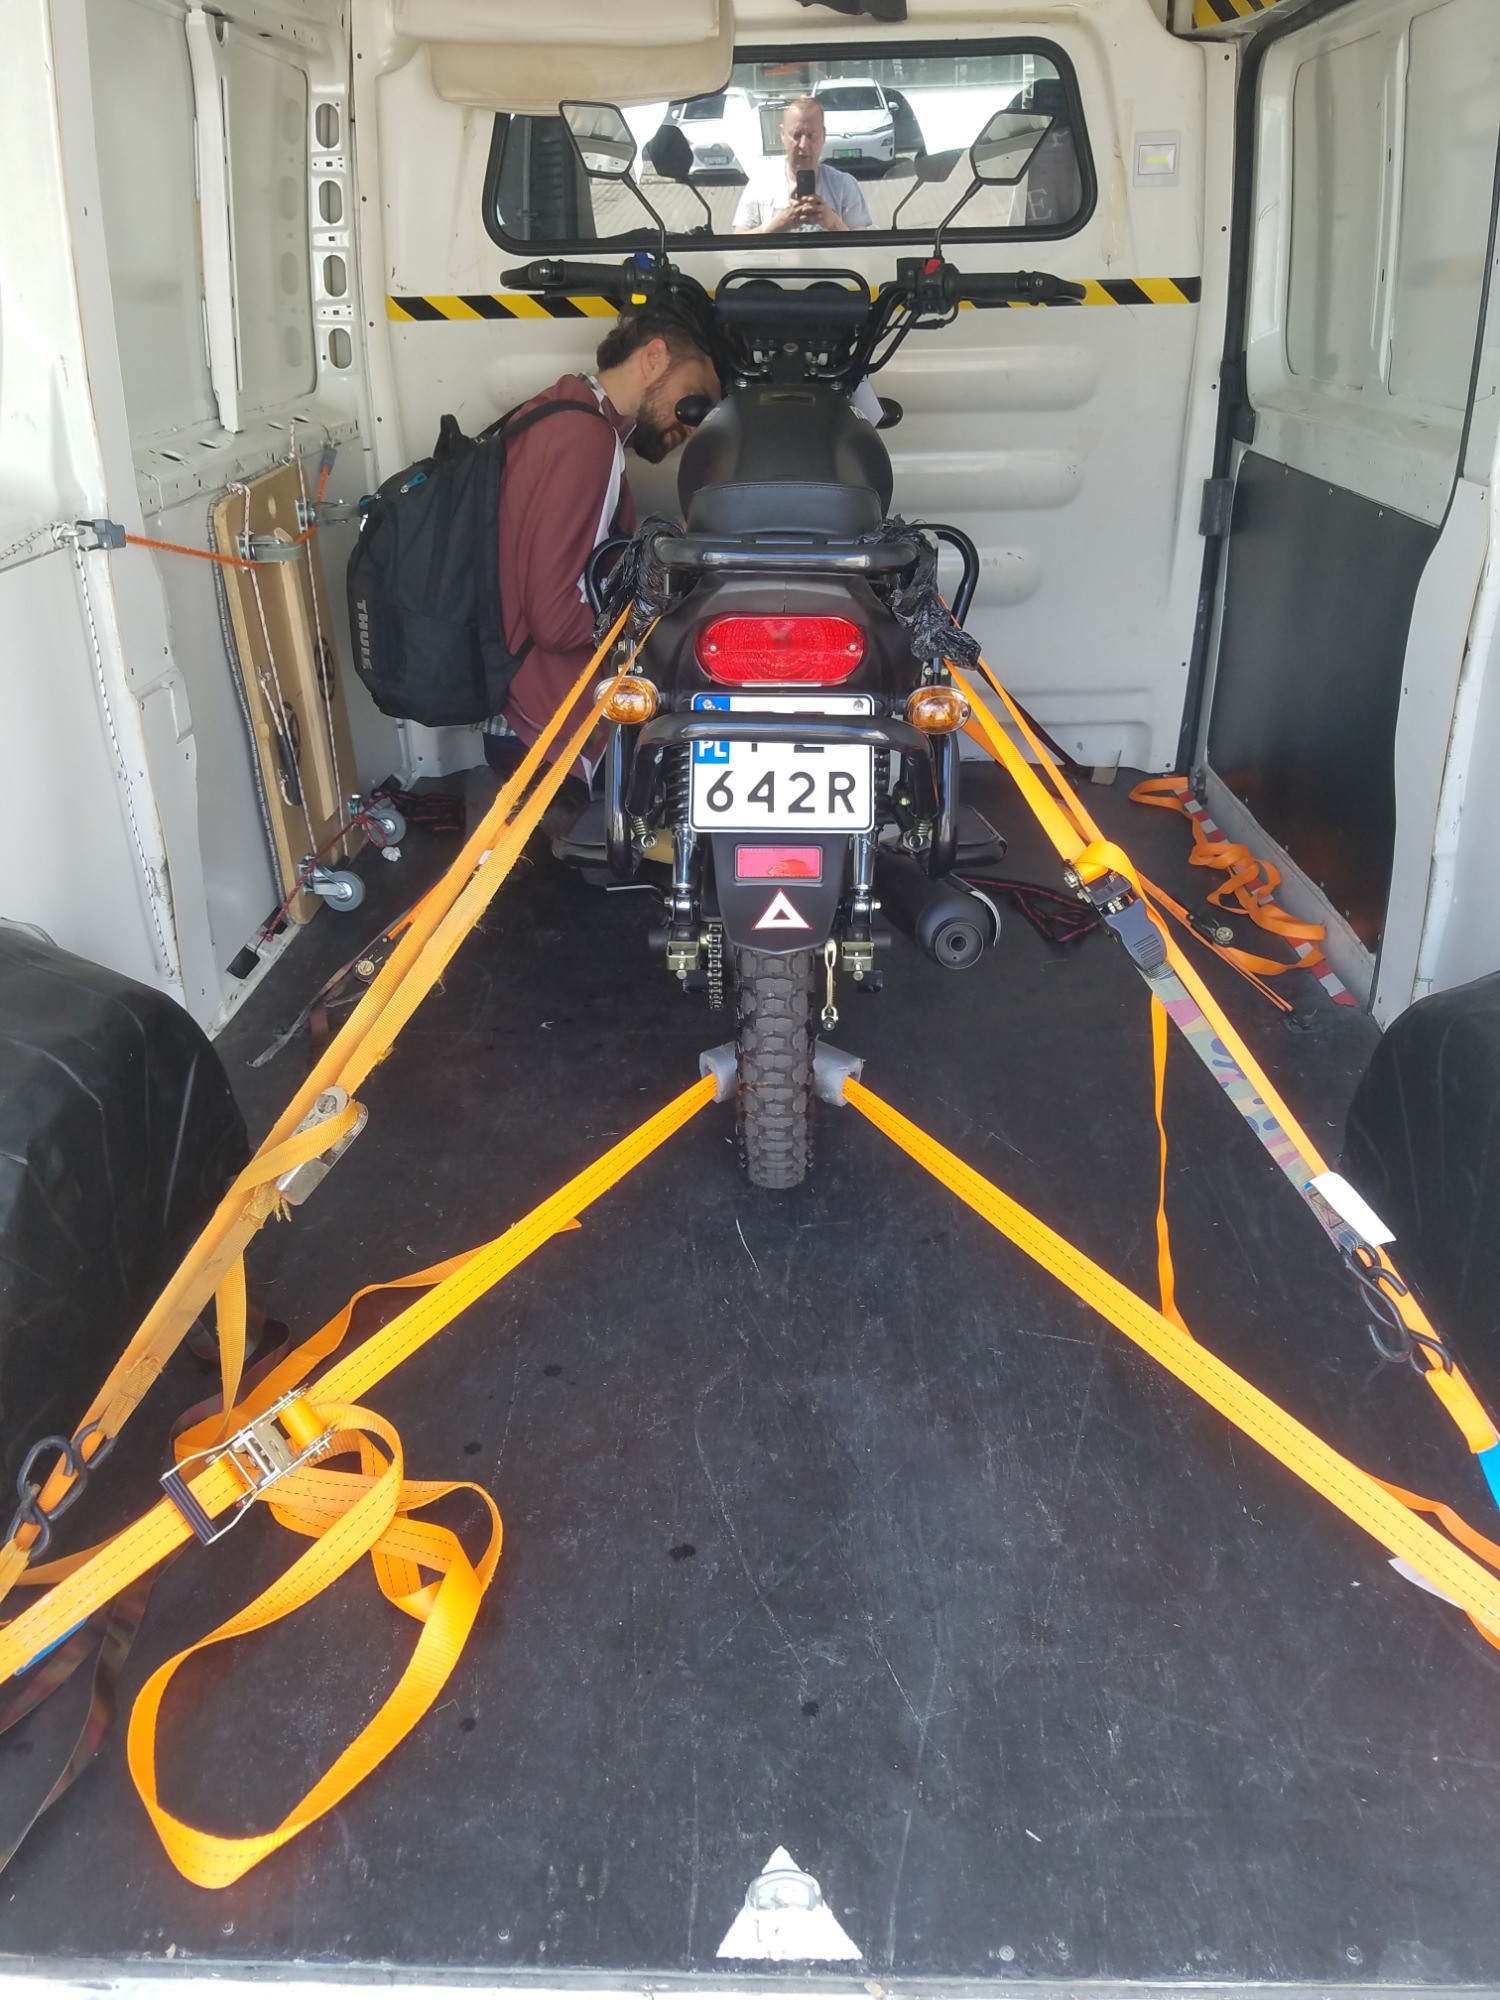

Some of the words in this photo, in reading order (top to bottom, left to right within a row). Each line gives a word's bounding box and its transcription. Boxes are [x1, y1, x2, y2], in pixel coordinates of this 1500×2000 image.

[357, 599, 373, 670] THULE
[699, 740, 727, 758] PL
[706, 770, 856, 814] 642R
